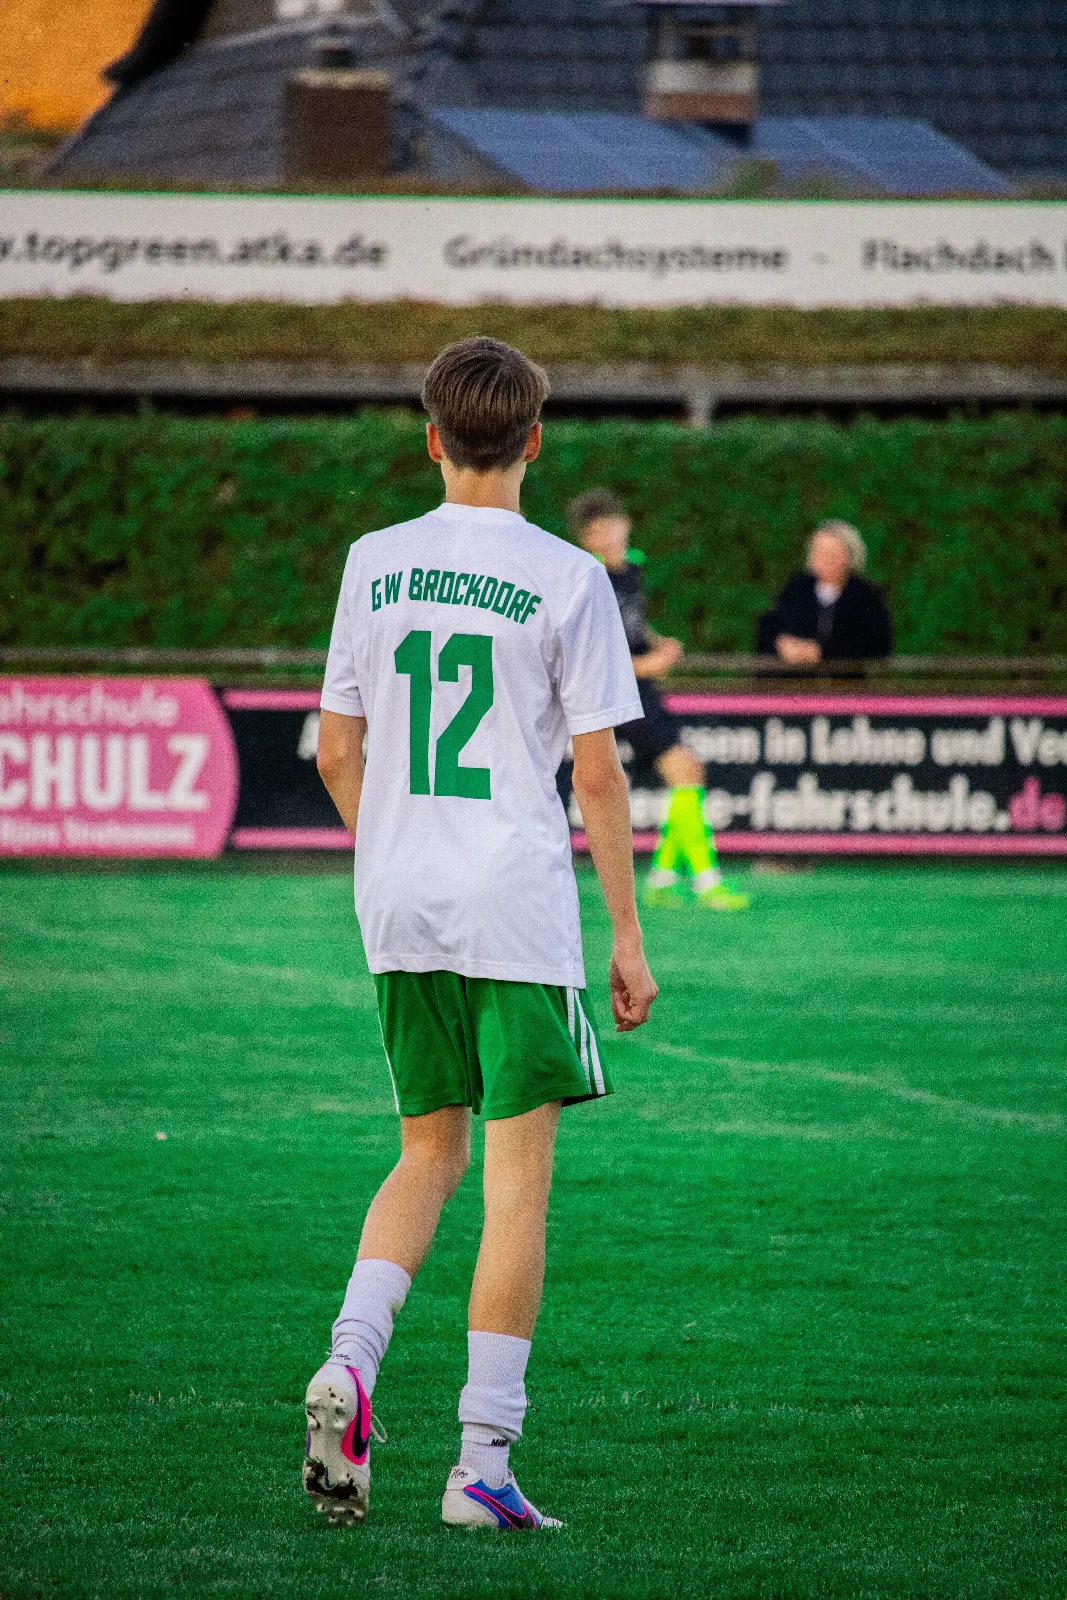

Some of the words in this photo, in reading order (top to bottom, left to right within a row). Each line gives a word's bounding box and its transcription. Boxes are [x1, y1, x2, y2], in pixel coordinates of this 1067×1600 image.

[371, 571, 403, 612] GW
[408, 567, 542, 625] BROCKDORF
[393, 629, 495, 800] 12
[765, 717, 807, 765] in
[811, 716, 927, 766] Lohne
[931, 716, 1006, 766] und
[0, 733, 210, 812] CHULZ
